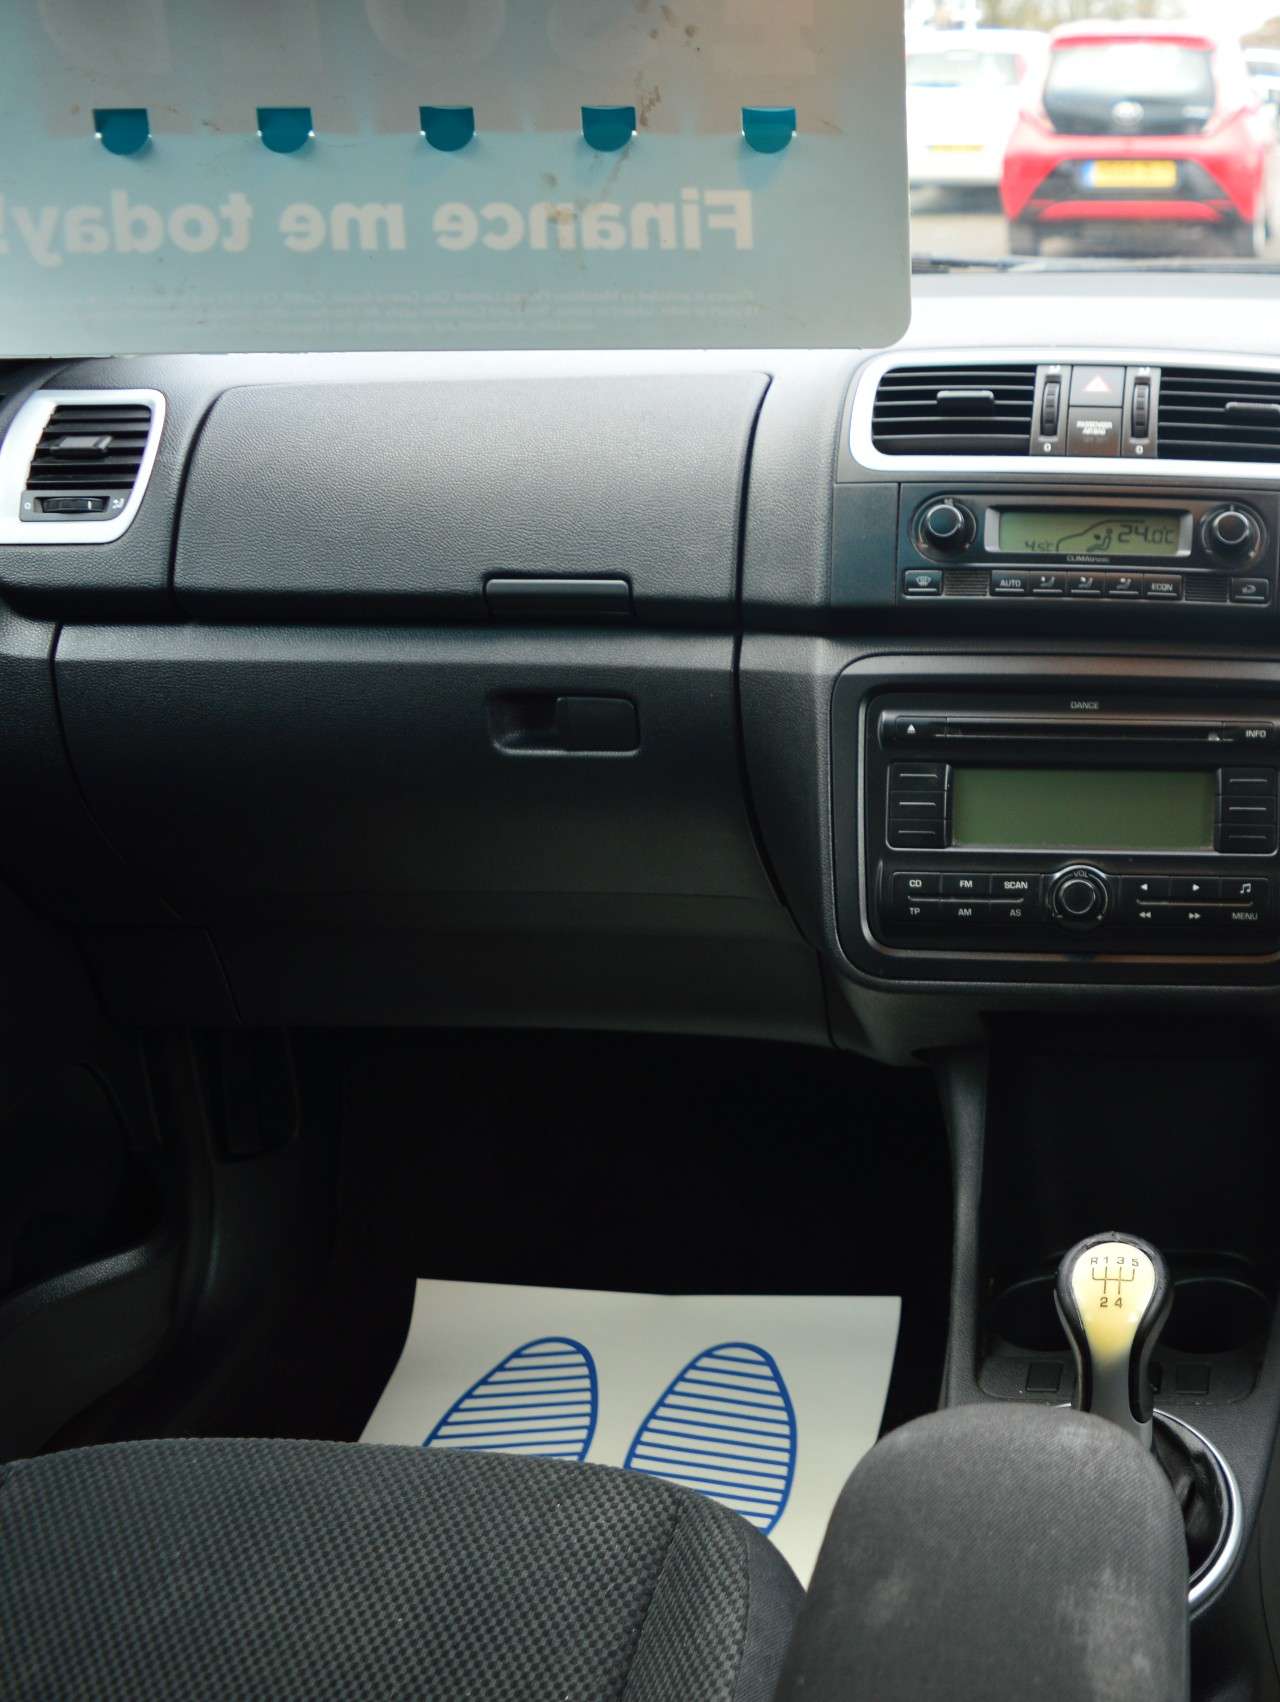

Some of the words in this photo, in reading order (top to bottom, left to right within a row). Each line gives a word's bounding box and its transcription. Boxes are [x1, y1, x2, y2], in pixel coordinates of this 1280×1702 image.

[1000, 579, 1021, 588] AUTO
[1152, 582, 1173, 592] ECON
[1070, 701, 1099, 710] DANCE
[1245, 729, 1267, 739] INFO
[909, 879, 922, 888] CD
[959, 880, 973, 888] FM
[1004, 881, 1028, 890] SCAN
[909, 907, 921, 916] TP
[958, 908, 972, 917] AM
[1009, 909, 1022, 917] AS
[1232, 912, 1258, 921] MENU
[1117, 1256, 1125, 1265] 3
[1099, 1296, 1109, 1308] 2
[1114, 1297, 1124, 1309] 4
